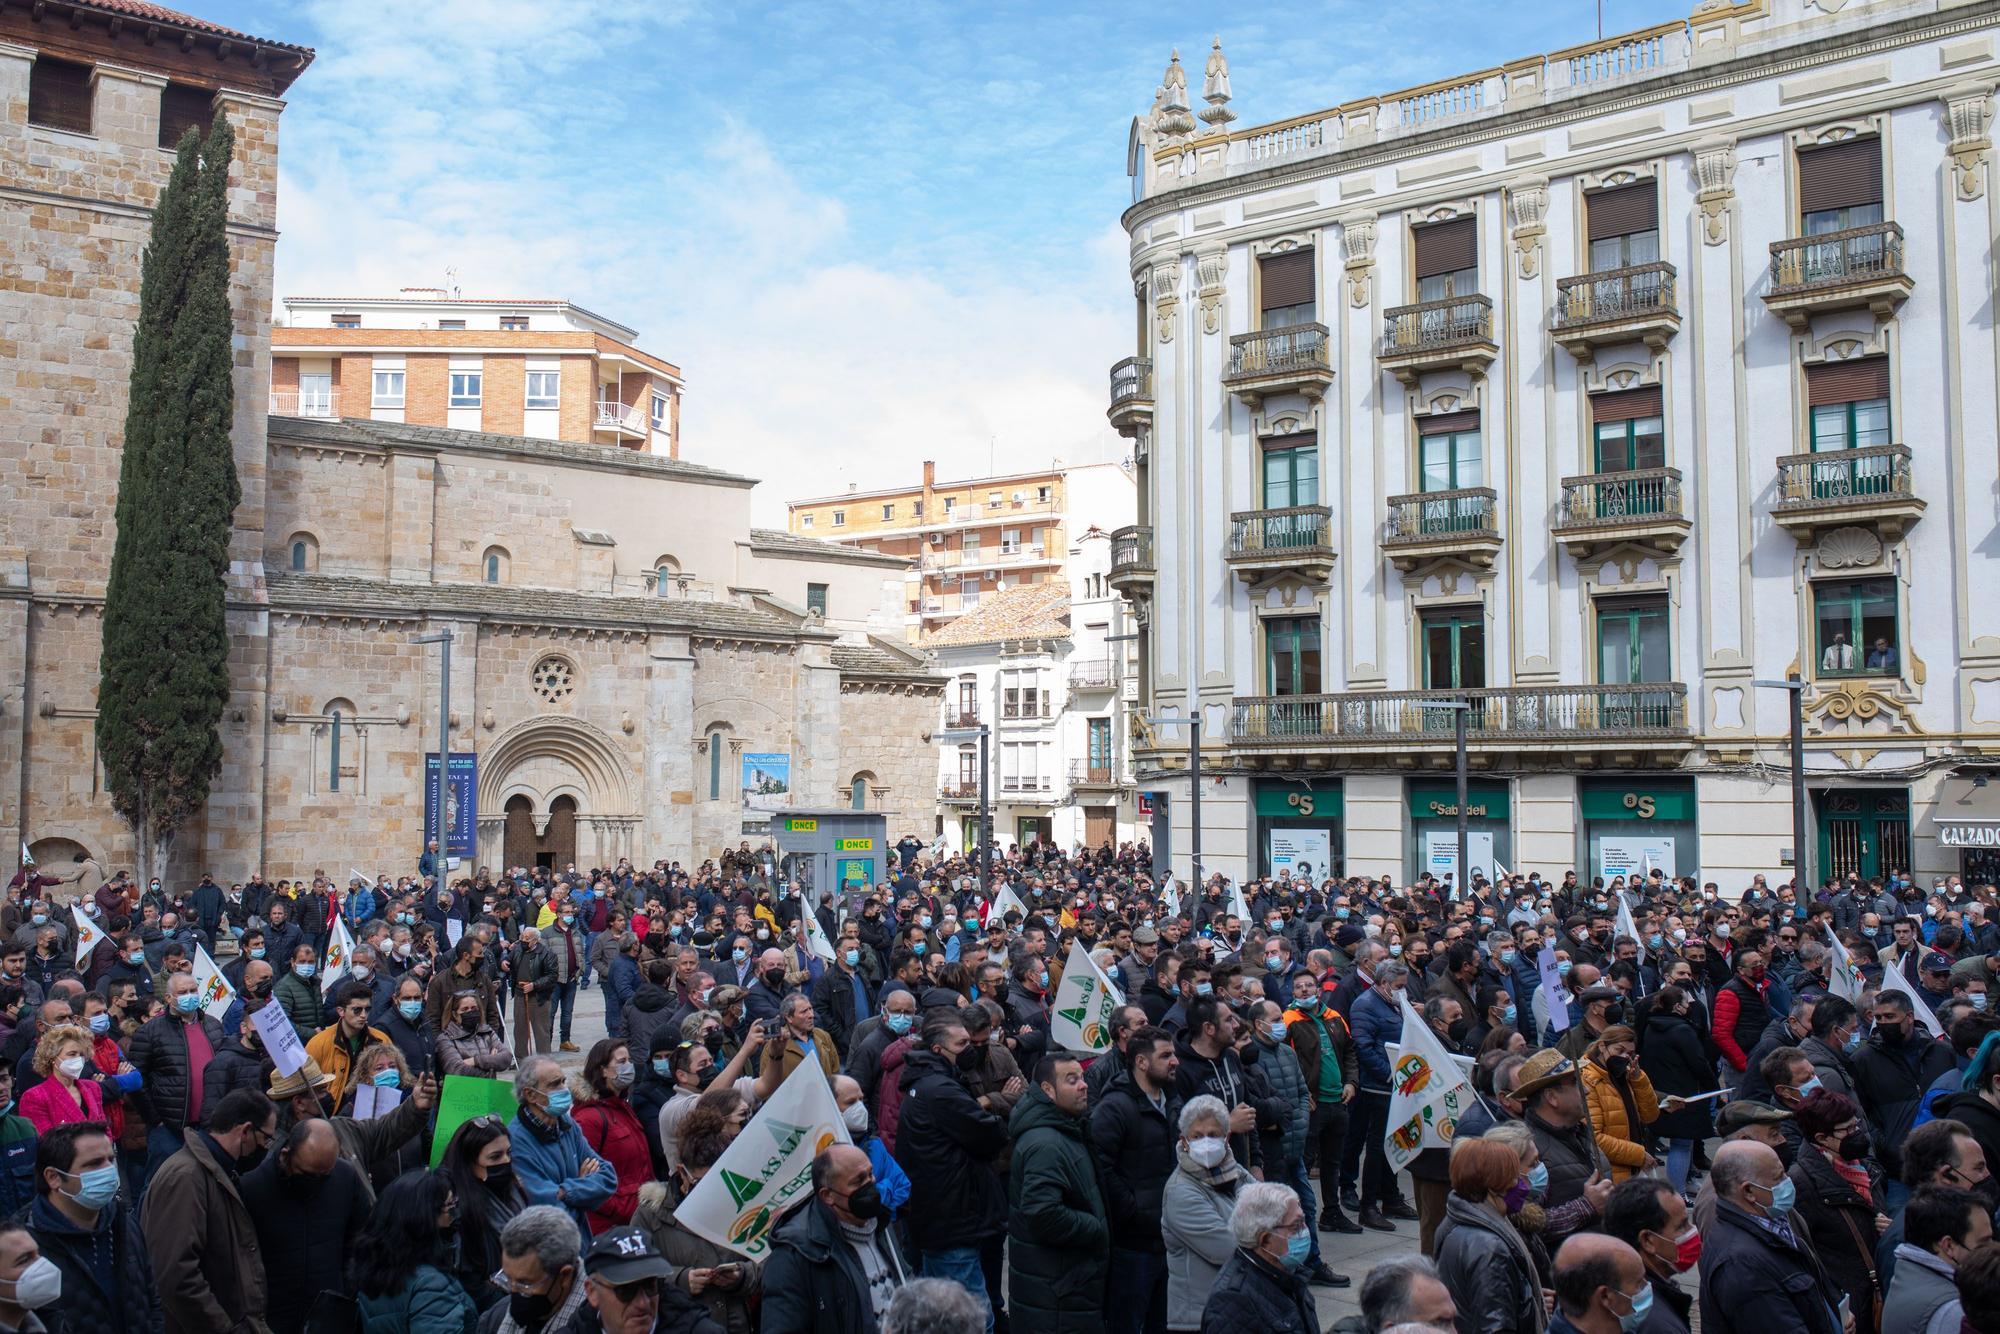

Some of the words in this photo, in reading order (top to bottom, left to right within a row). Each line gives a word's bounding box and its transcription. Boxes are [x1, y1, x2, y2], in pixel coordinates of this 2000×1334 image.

[1436, 803, 1487, 816] Sabdell
[794, 821, 814, 830] ONCE
[846, 840, 870, 849] ONCE
[759, 1126, 809, 1183] ASAJA
